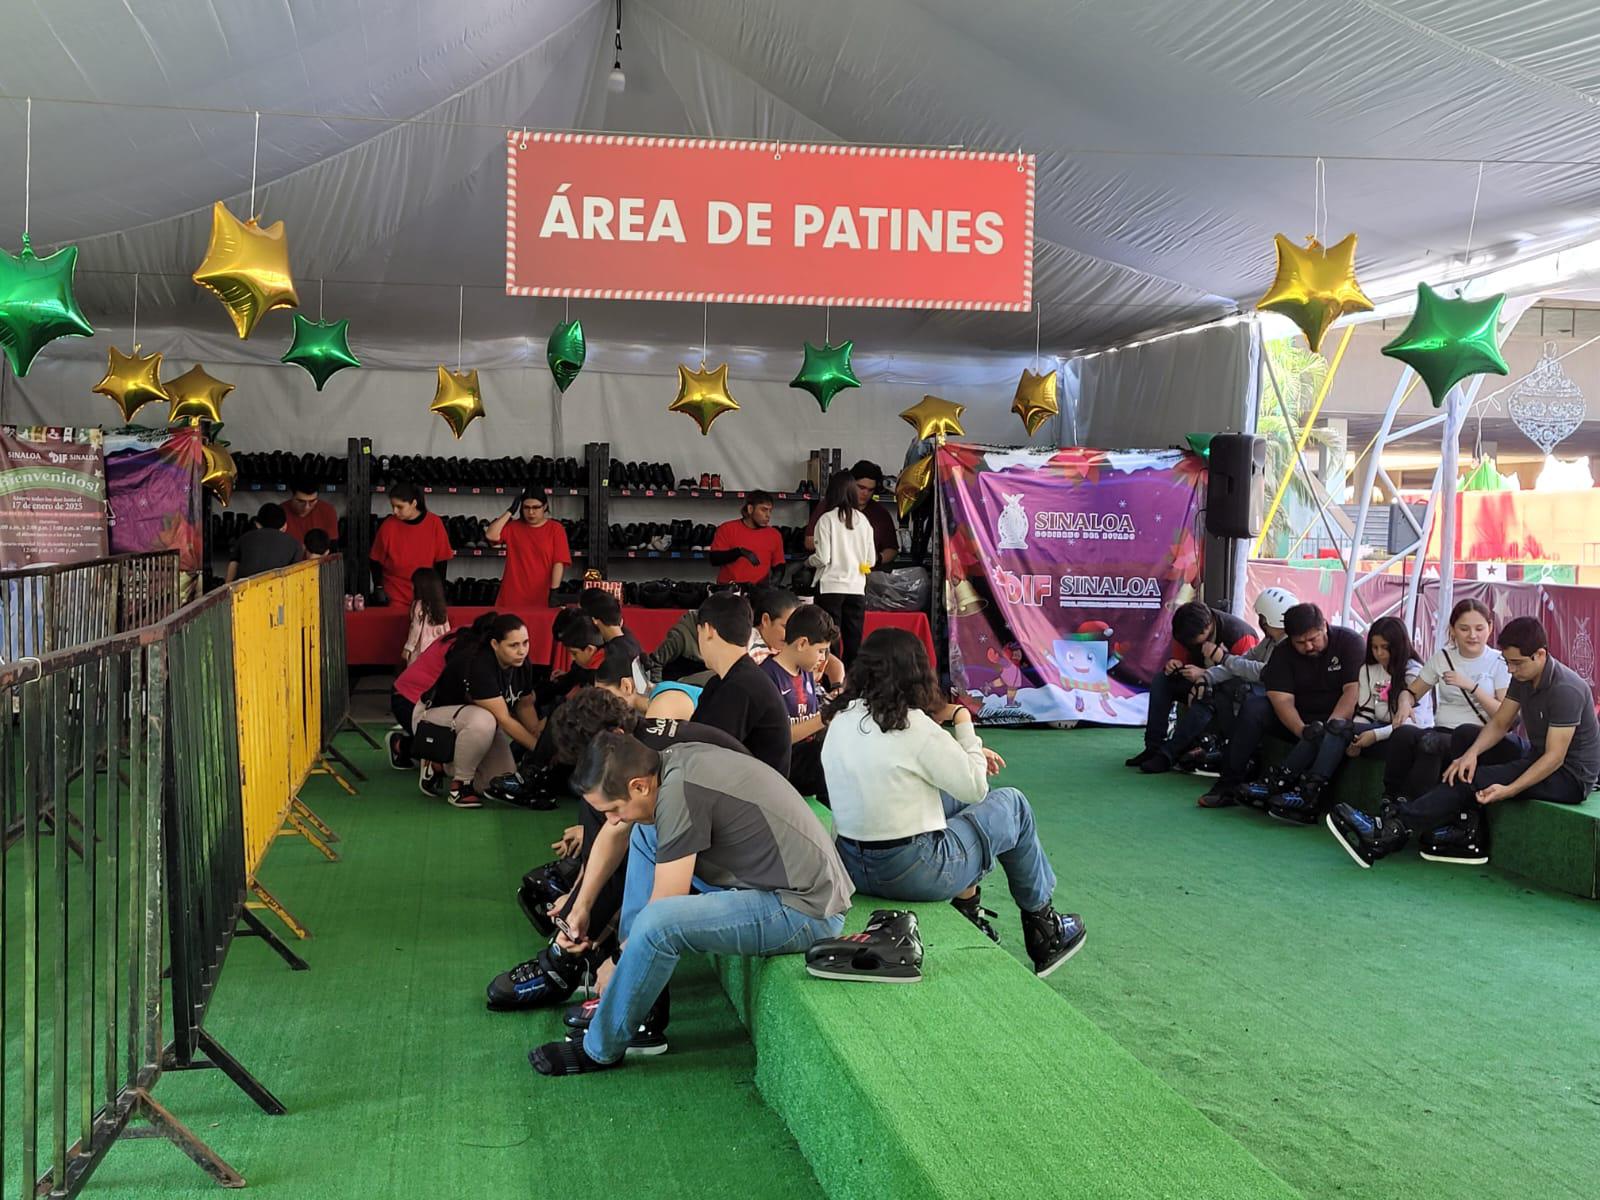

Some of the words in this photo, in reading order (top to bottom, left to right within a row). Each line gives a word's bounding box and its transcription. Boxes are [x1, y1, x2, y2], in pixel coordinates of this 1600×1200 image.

[539, 183, 687, 244] ÁREA
[707, 201, 773, 246] DE
[793, 204, 1005, 255] PATINES
[7, 451, 41, 460] SINALOA
[52, 453, 68, 464] DIF
[22, 501, 32, 509] de
[54, 502, 64, 510] de
[65, 502, 83, 511] 2025
[1034, 511, 1136, 533] SINALOA
[1003, 573, 1052, 607] DIF
[1060, 575, 1161, 597] SINALOA
